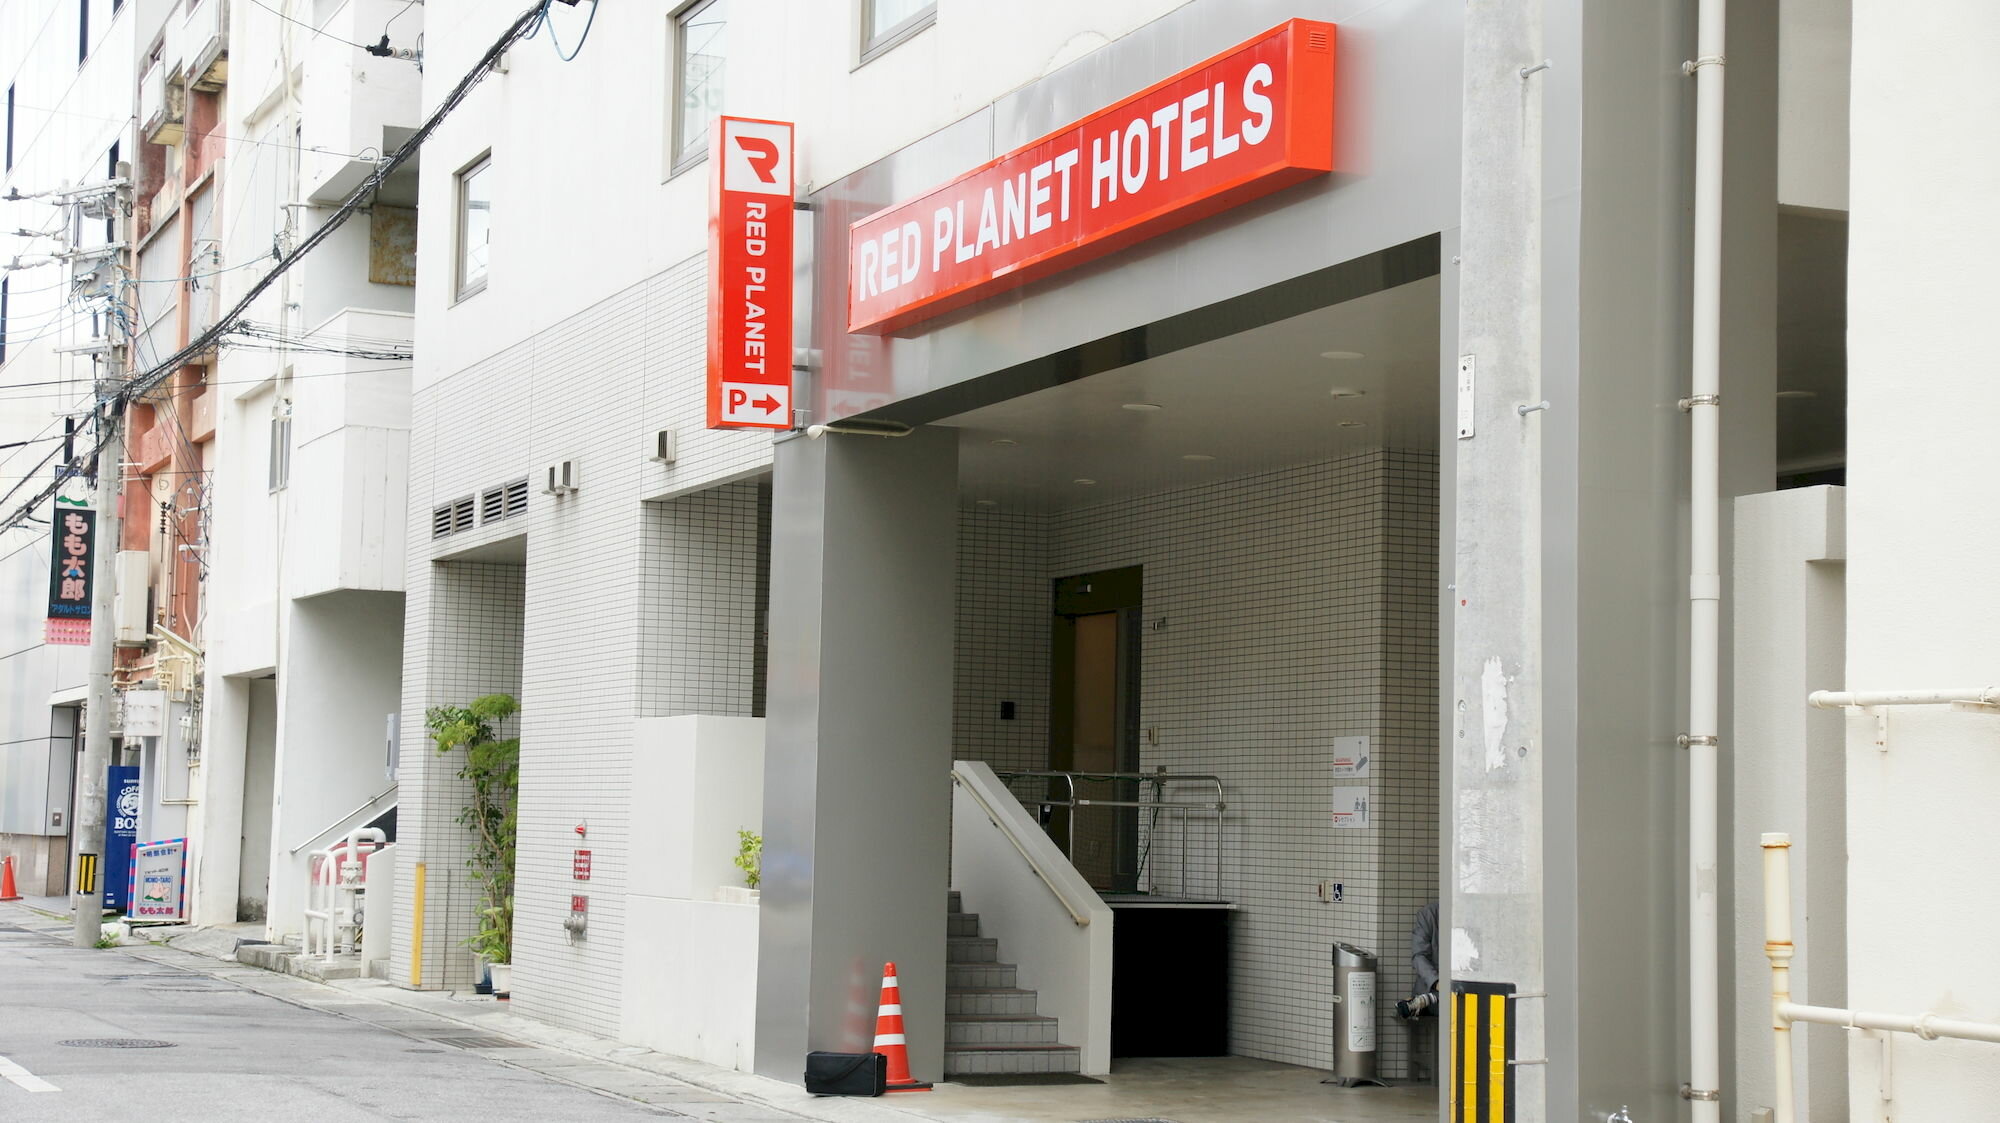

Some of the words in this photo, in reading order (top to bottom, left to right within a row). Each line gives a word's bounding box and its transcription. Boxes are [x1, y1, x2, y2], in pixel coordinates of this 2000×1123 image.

[859, 220, 921, 302] RED
[932, 148, 1079, 273] PLANET
[1091, 62, 1273, 209] HOTELS
[746, 202, 766, 256] RED
[745, 267, 766, 374] PLANET
[728, 388, 748, 415] P
[60, 512, 89, 601] もも太郎
[139, 906, 174, 915] もも太郎
